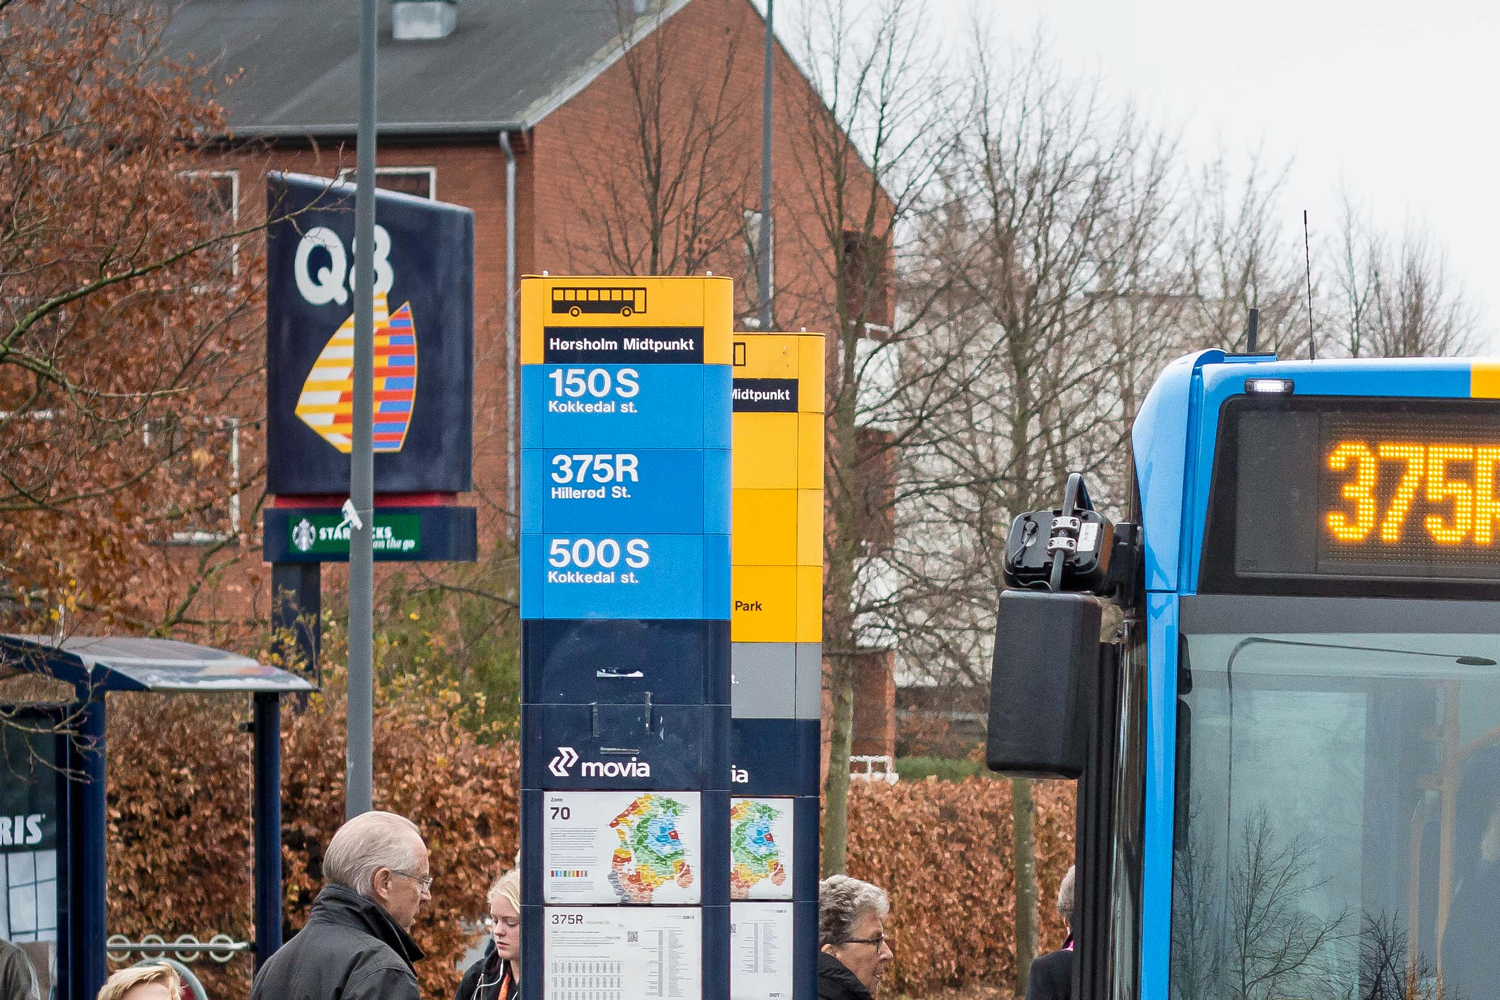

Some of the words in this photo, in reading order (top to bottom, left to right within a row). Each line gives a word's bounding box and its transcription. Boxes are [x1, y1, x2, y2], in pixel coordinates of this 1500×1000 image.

[294, 224, 395, 306] Q8
[549, 337, 618, 351] Hørsholm
[623, 337, 695, 353] Midtpunkt
[548, 368, 612, 398] 150
[615, 368, 640, 398] S
[548, 400, 616, 414] Kokkedal
[620, 402, 638, 414] st.
[551, 453, 639, 484] 375R
[551, 486, 606, 499] Hillerød
[611, 486, 632, 498] St.
[386, 538, 401, 549] the
[402, 540, 416, 552] go
[548, 538, 621, 569] 500
[625, 538, 650, 569] S
[548, 570, 615, 584] Kokkedal
[620, 572, 639, 584] st.
[734, 600, 763, 612] Park
[580, 758, 651, 778] movia
[550, 806, 571, 820] 70
[551, 914, 584, 925] 375R
